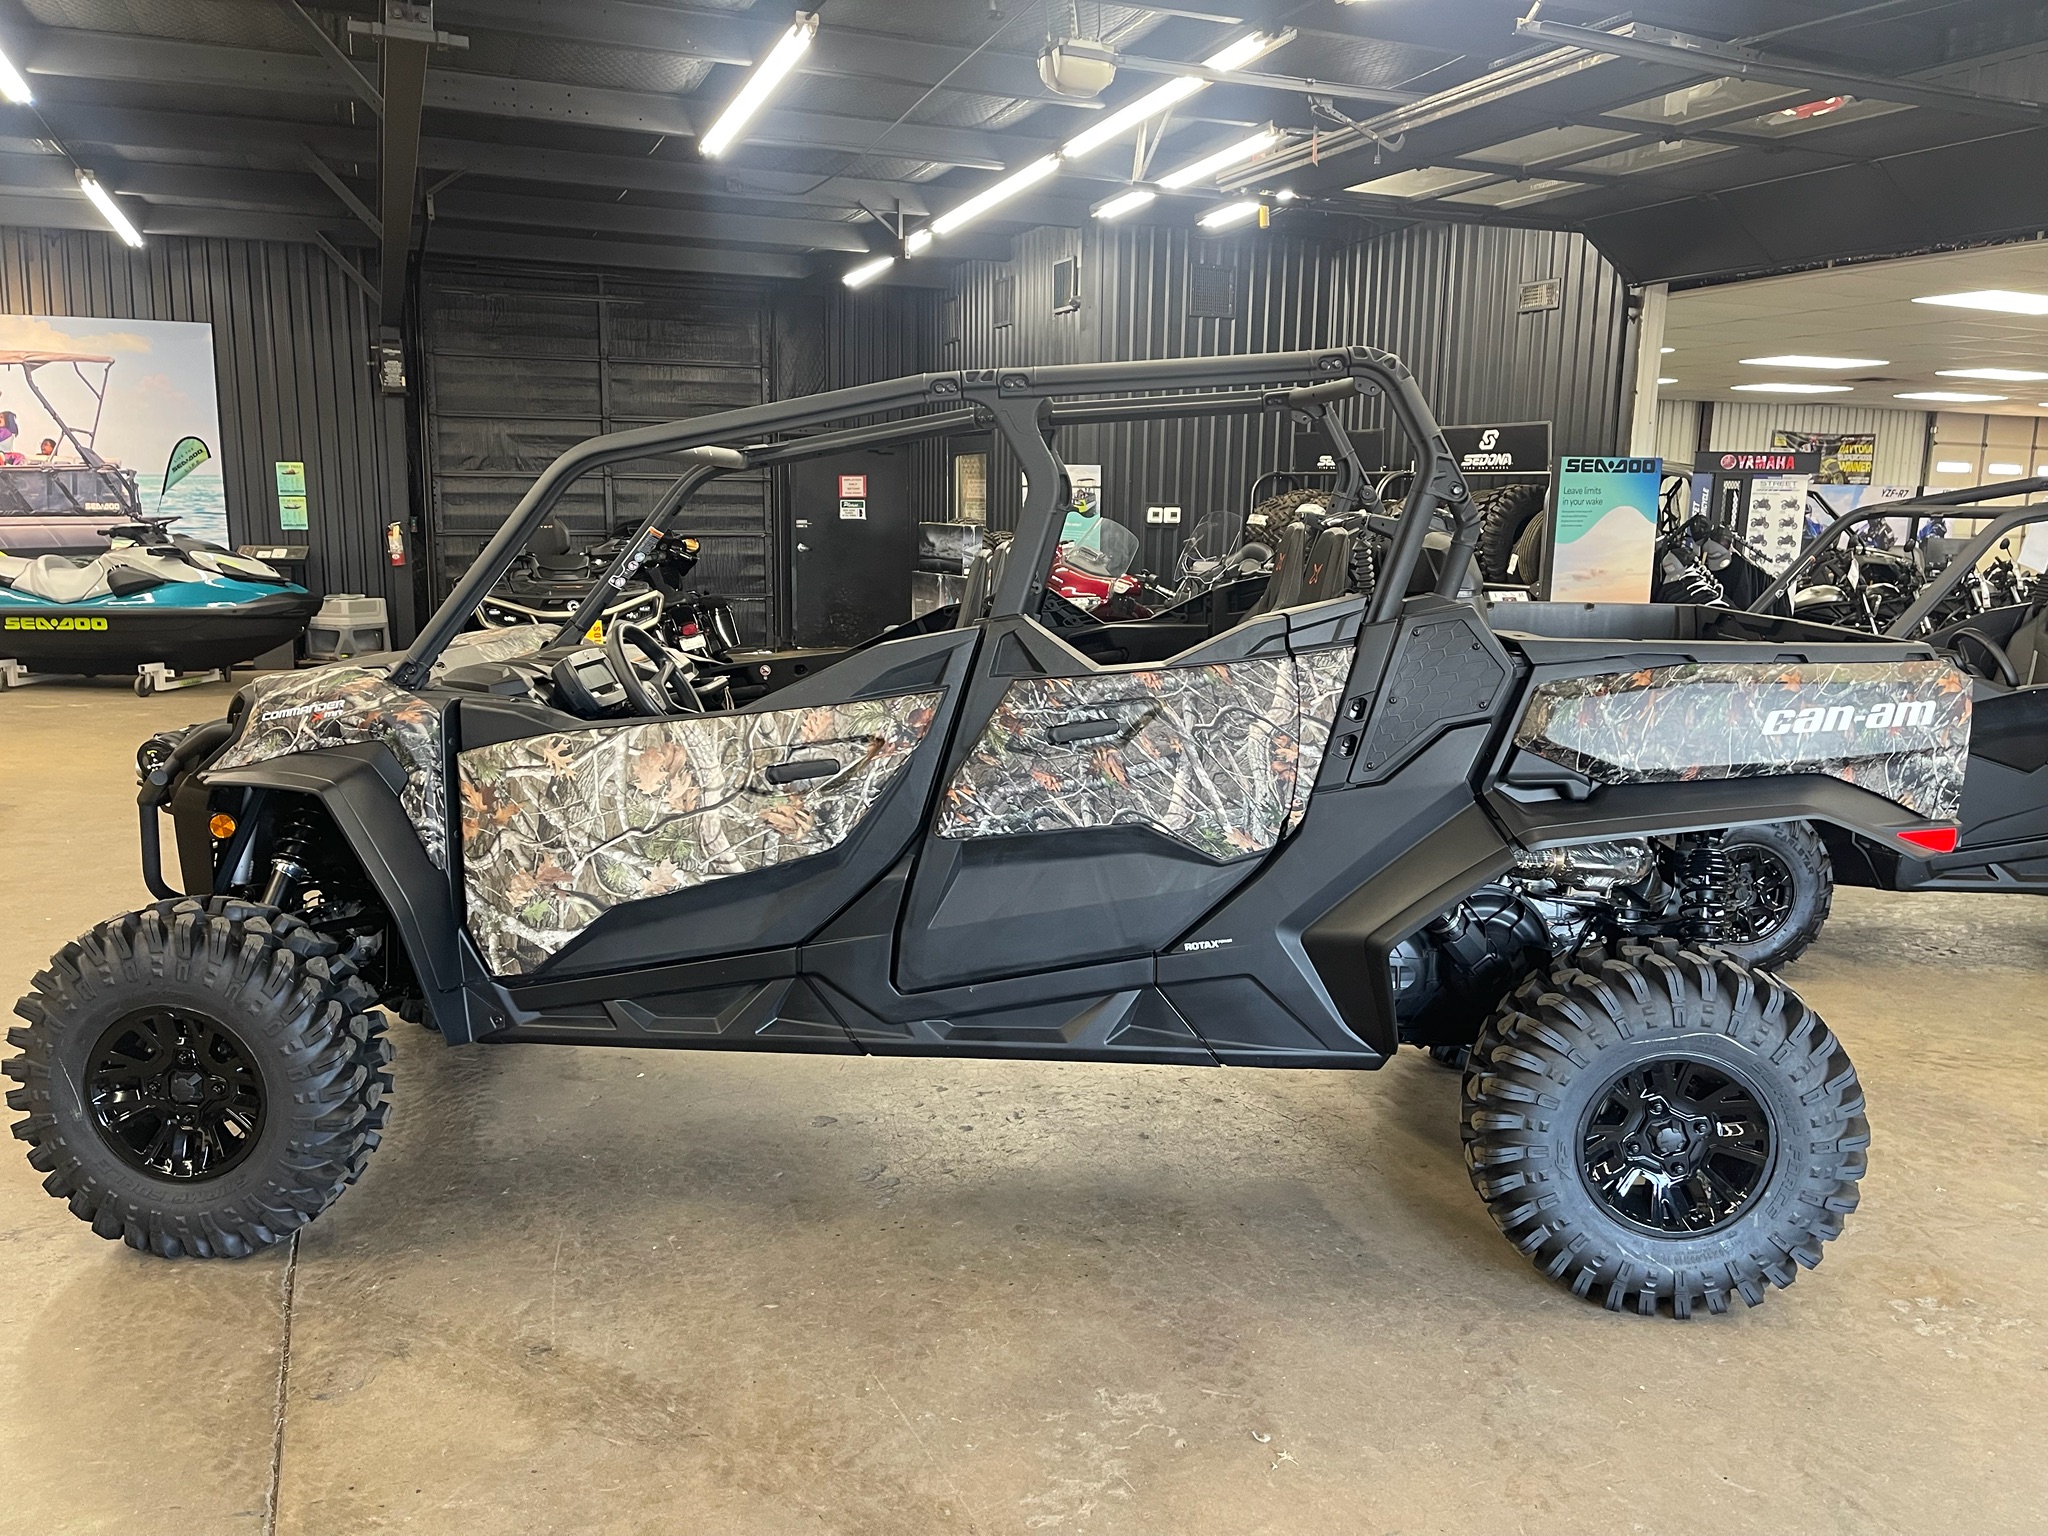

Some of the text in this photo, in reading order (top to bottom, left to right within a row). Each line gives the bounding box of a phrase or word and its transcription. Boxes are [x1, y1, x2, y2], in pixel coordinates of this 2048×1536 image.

[1839, 444, 1873, 454] DAYTONA
[1461, 453, 1512, 466] SEDONA
[1738, 455, 1795, 470] YAMAHA
[1838, 461, 1872, 473] WINNER
[1760, 480, 1798, 488] STREET
[1563, 486, 1602, 495] Leave limits
[1881, 488, 1910, 498] YZF-R7
[1562, 497, 1604, 508] in your wake
[262, 699, 346, 722] COMMANDER
[1761, 700, 1937, 736] can-am
[1773, 829, 1816, 876] CARLSTAR
[1184, 939, 1220, 951] ROTAX
